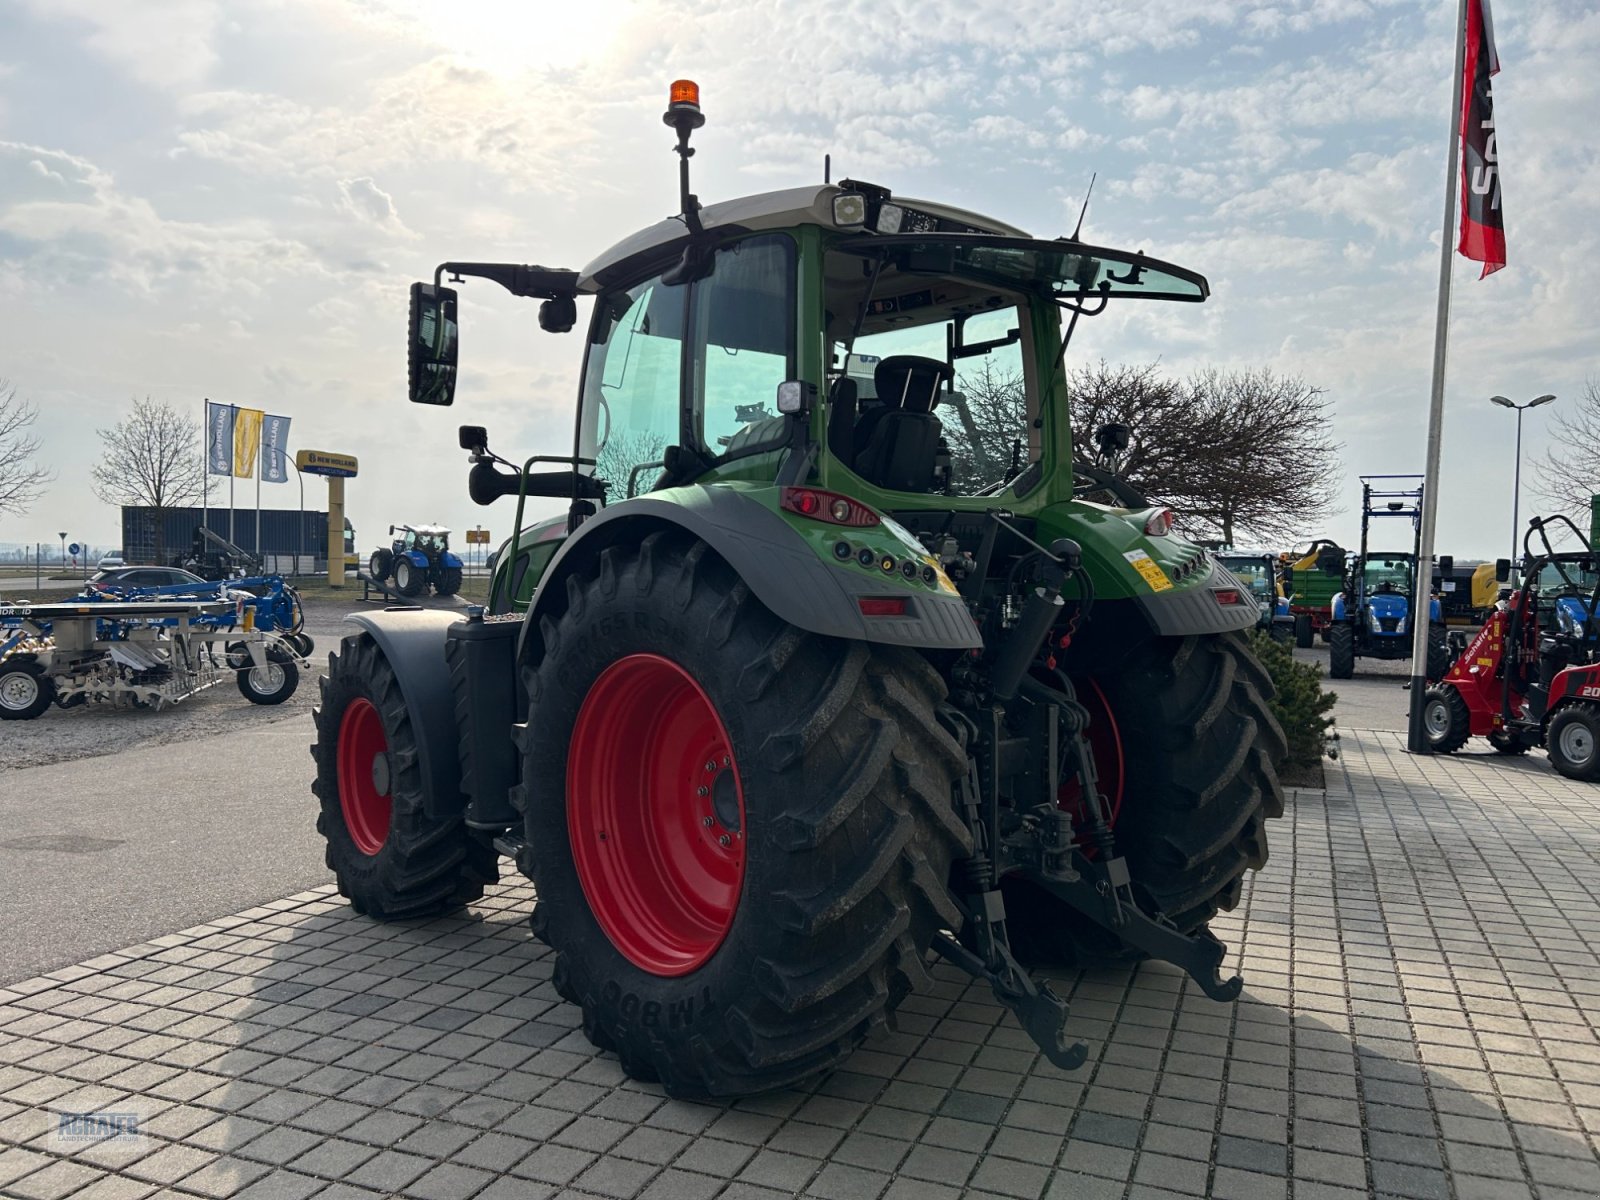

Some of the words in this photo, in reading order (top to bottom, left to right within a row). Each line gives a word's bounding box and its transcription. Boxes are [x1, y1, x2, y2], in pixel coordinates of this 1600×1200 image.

[217, 408, 226, 442] HOLLAND
[317, 456, 330, 464] NEW
[331, 458, 356, 467] HOLLAND
